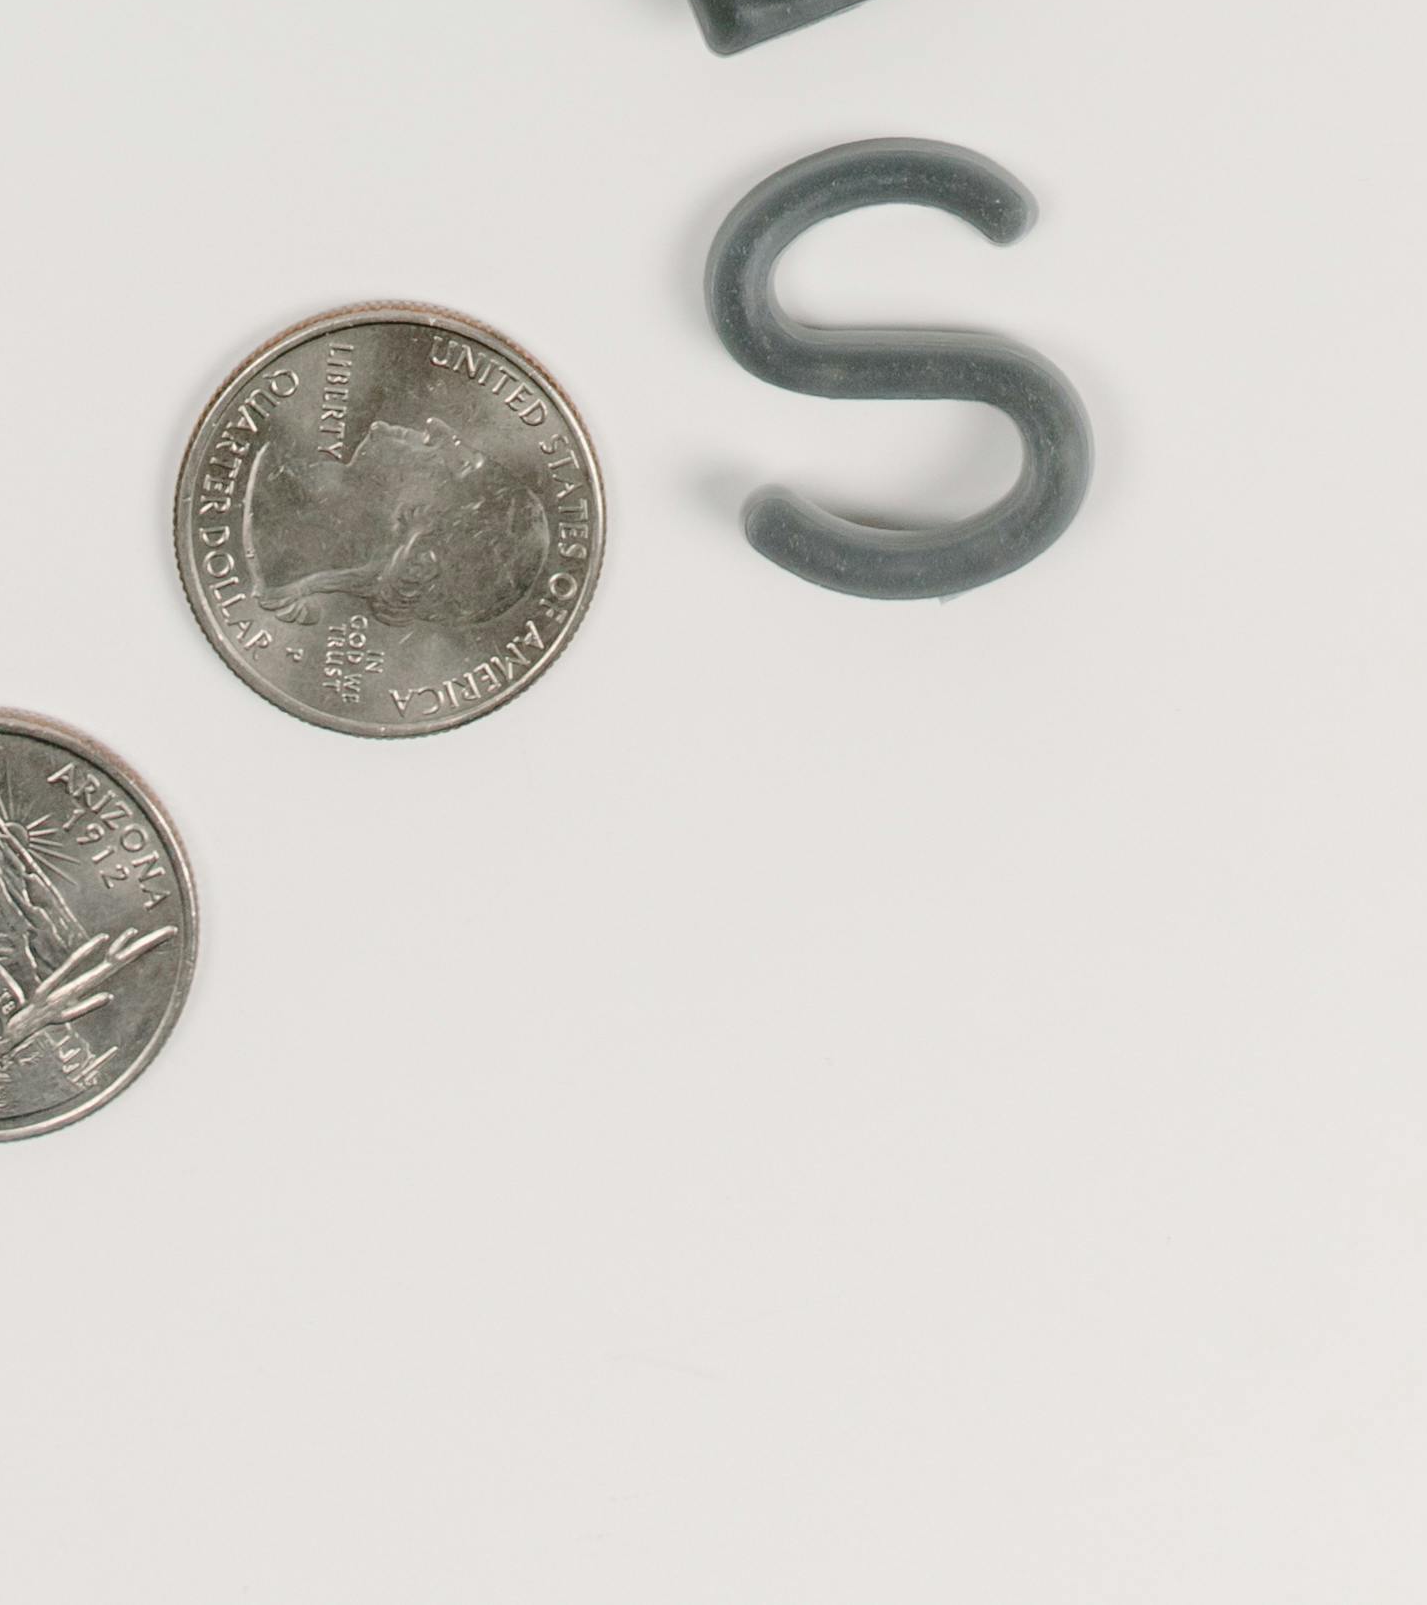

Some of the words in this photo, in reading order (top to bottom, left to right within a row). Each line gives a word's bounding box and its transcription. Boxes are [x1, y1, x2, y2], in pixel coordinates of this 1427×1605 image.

[198, 368, 302, 517] QUARTER
[317, 342, 355, 465] LIBERTY
[429, 335, 551, 429] UNITED
[540, 433, 589, 562] STATES
[199, 527, 274, 660] DOLLAR
[542, 572, 576, 625] OF
[388, 620, 546, 718] AMERICA
[46, 762, 172, 911] ARIZONA
[62, 810, 128, 890] 1912
